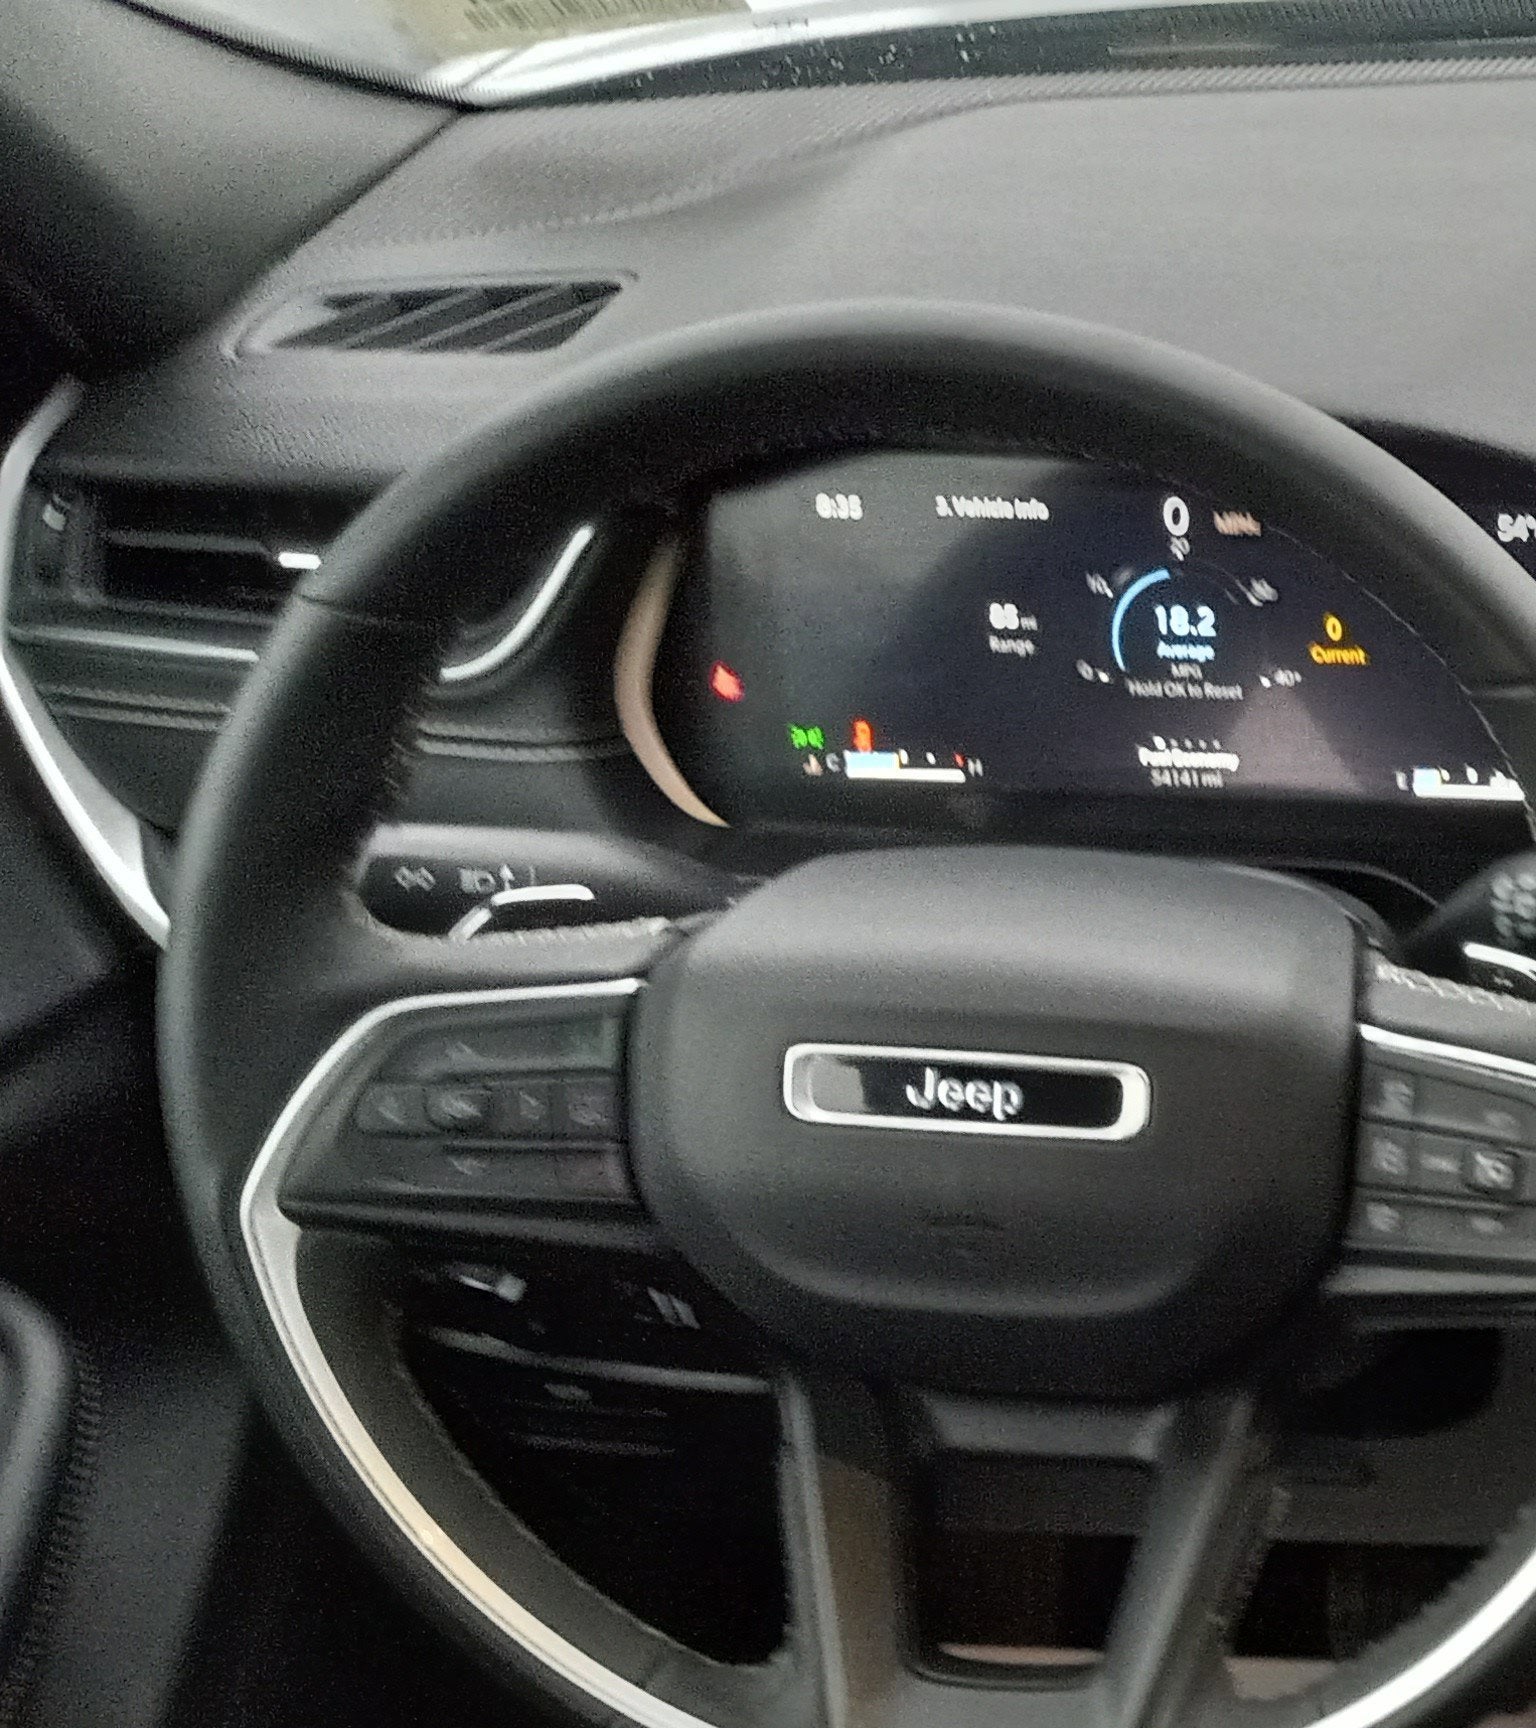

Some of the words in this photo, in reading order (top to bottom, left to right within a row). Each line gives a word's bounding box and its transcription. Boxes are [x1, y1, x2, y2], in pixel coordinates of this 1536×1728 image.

[1163, 496, 1190, 536] 0
[1155, 604, 1216, 637] 18.2
[1323, 611, 1343, 642] 0
[1309, 642, 1368, 666] Current
[906, 1067, 1024, 1121] Jeep
